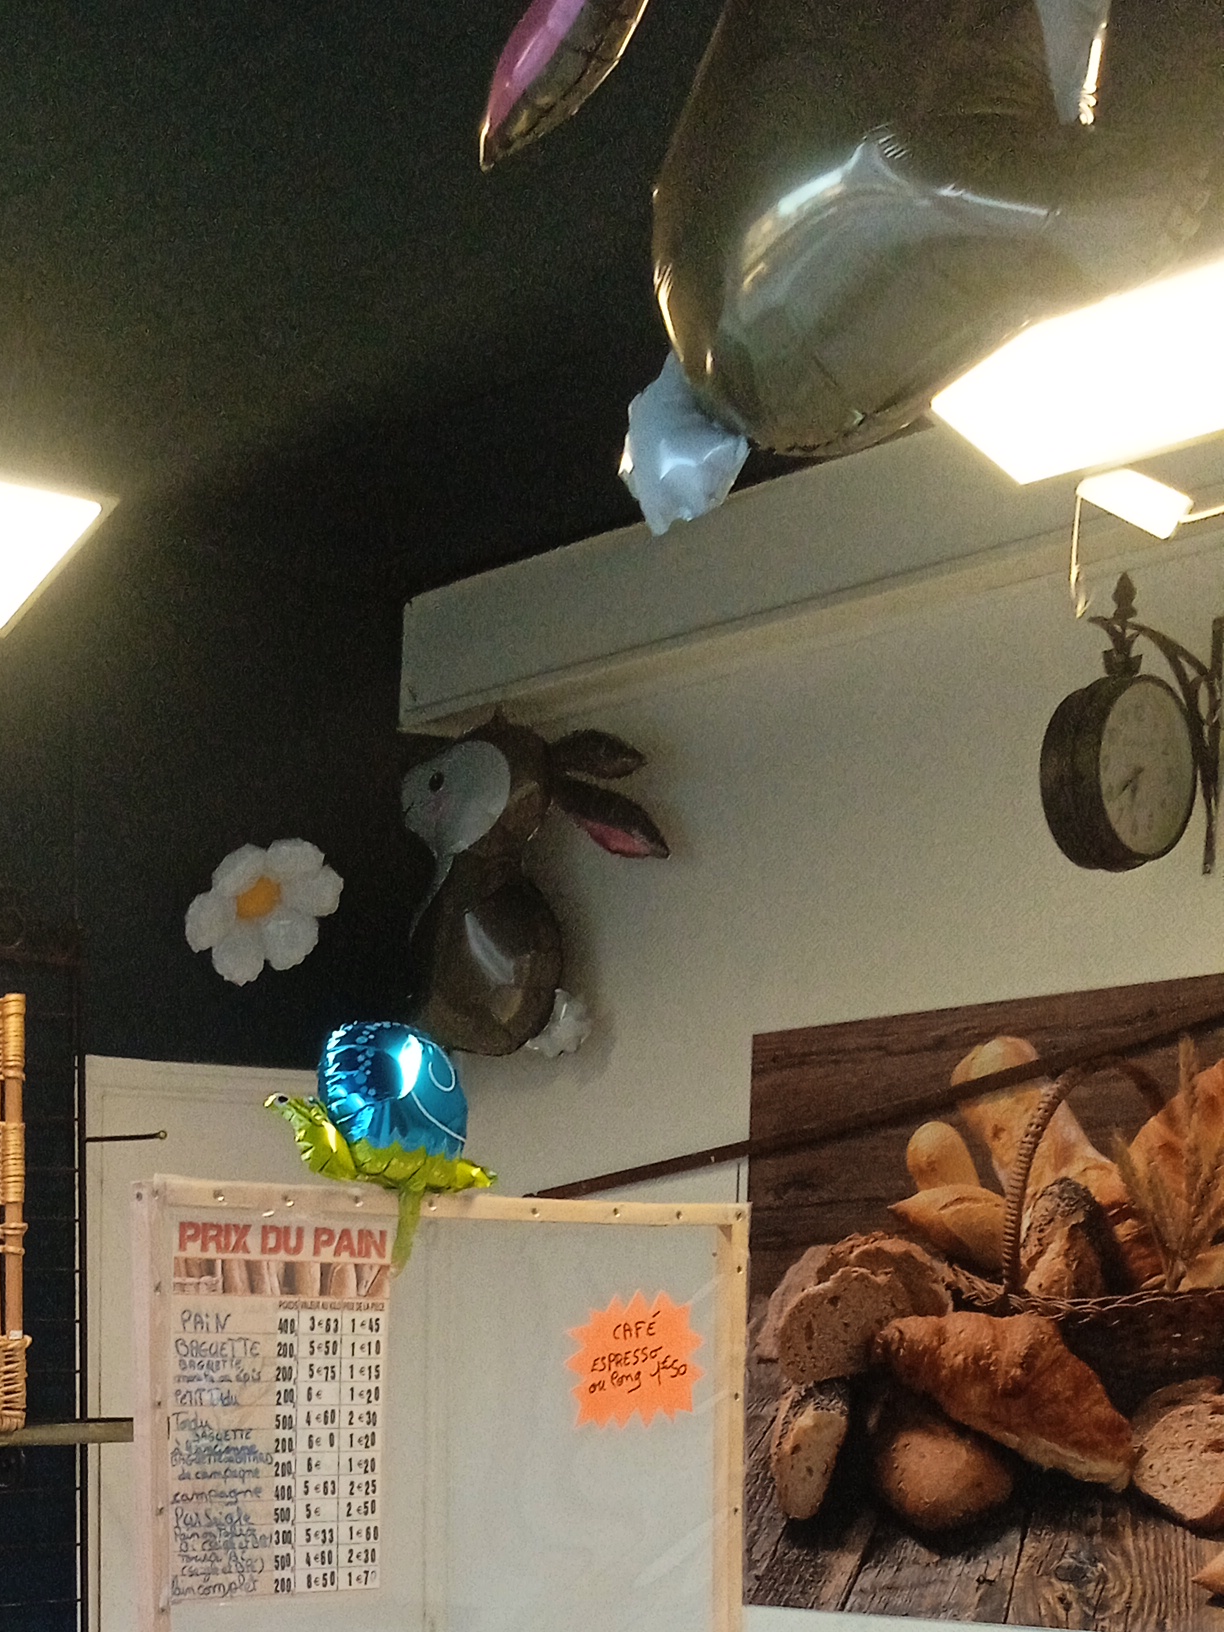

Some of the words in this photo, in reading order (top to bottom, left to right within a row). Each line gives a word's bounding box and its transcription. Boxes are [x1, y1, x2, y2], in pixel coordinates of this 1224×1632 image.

[178, 1221, 251, 1254] PRIX
[261, 1224, 304, 1256] DU
[313, 1227, 387, 1259] PAIN
[613, 1310, 660, 1340] CAFÉ
[591, 1346, 663, 1372] ESPRESSO
